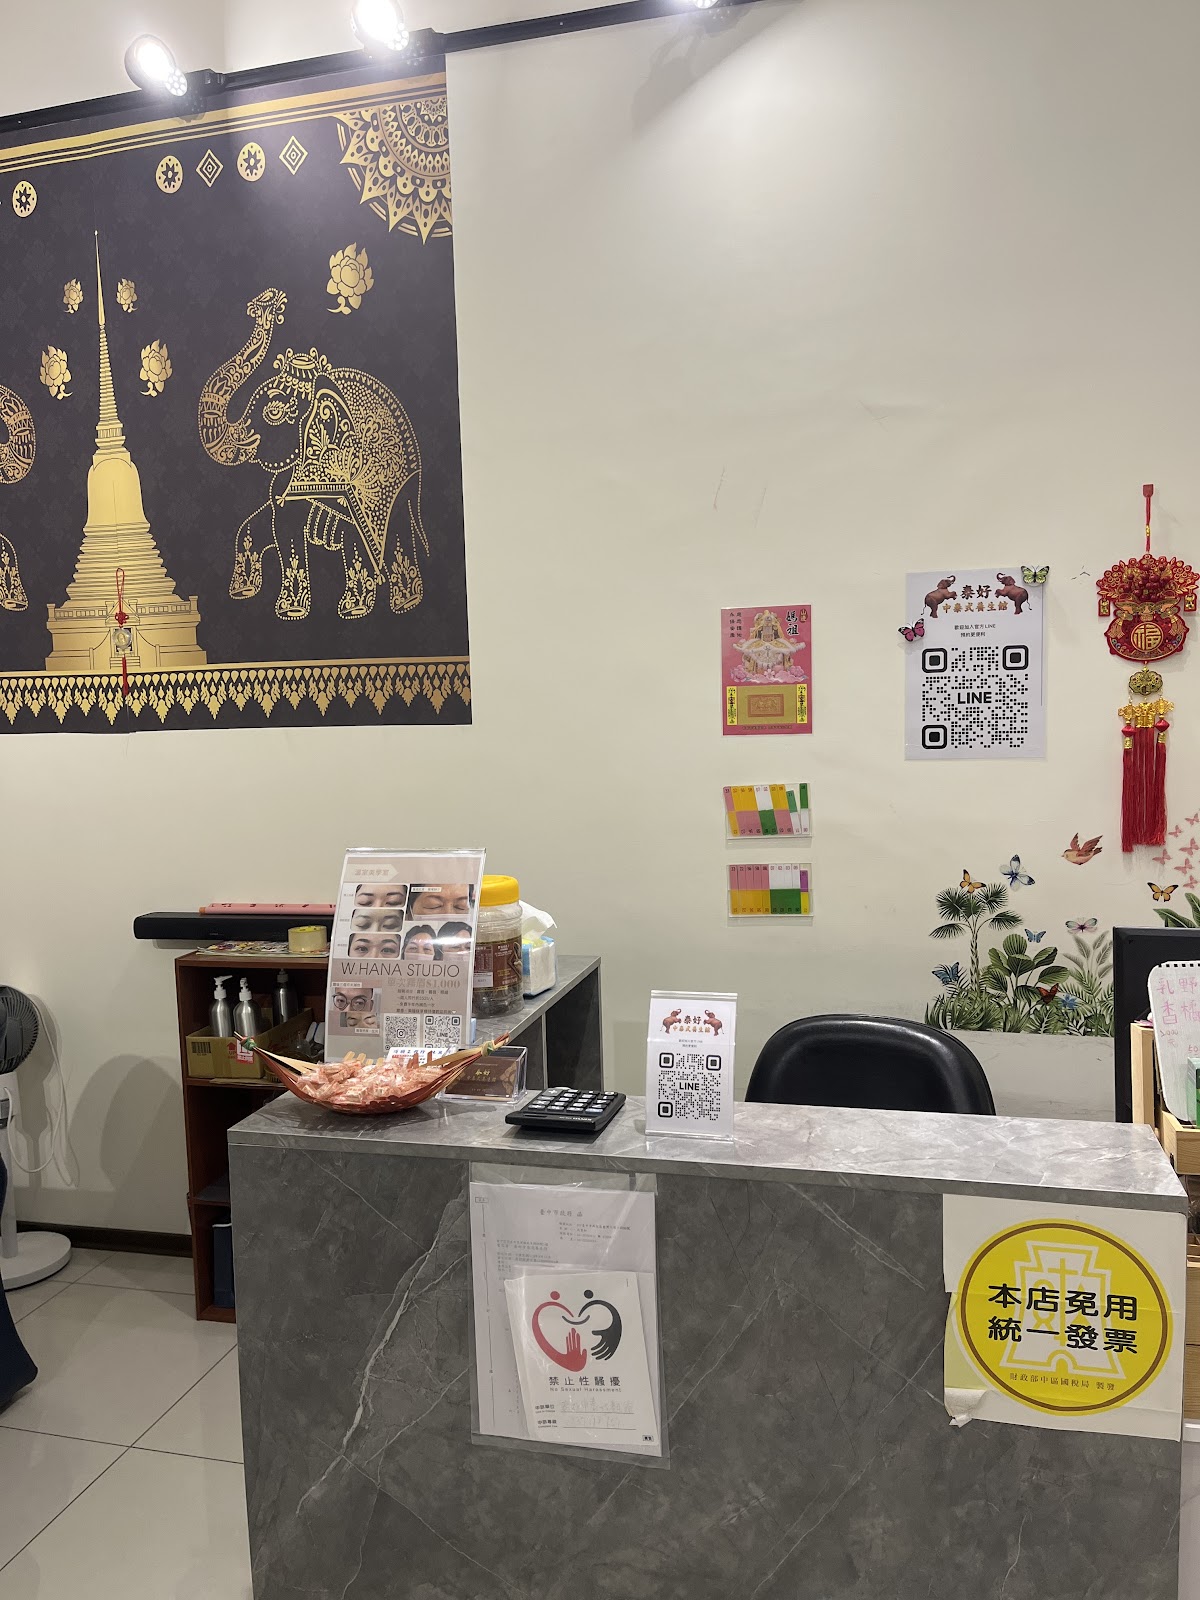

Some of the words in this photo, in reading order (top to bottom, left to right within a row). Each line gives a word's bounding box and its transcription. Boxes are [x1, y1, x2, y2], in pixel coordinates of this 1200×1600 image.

[960, 584, 993, 600] 泰好
[942, 601, 1009, 613] 中泰式養生館
[1132, 624, 1163, 650] 福
[957, 692, 992, 704] LINE
[341, 962, 402, 977] W.HANA
[407, 963, 460, 978] STUDIO
[684, 1015, 702, 1025] 泰好
[679, 1082, 700, 1091] LINE
[988, 1283, 1138, 1321] 本店免用
[988, 1315, 1138, 1354] 統一發票
[548, 1376, 621, 1387] 禁止性騷擾
[1009, 1372, 1090, 1388] 財政部中區國稅局
